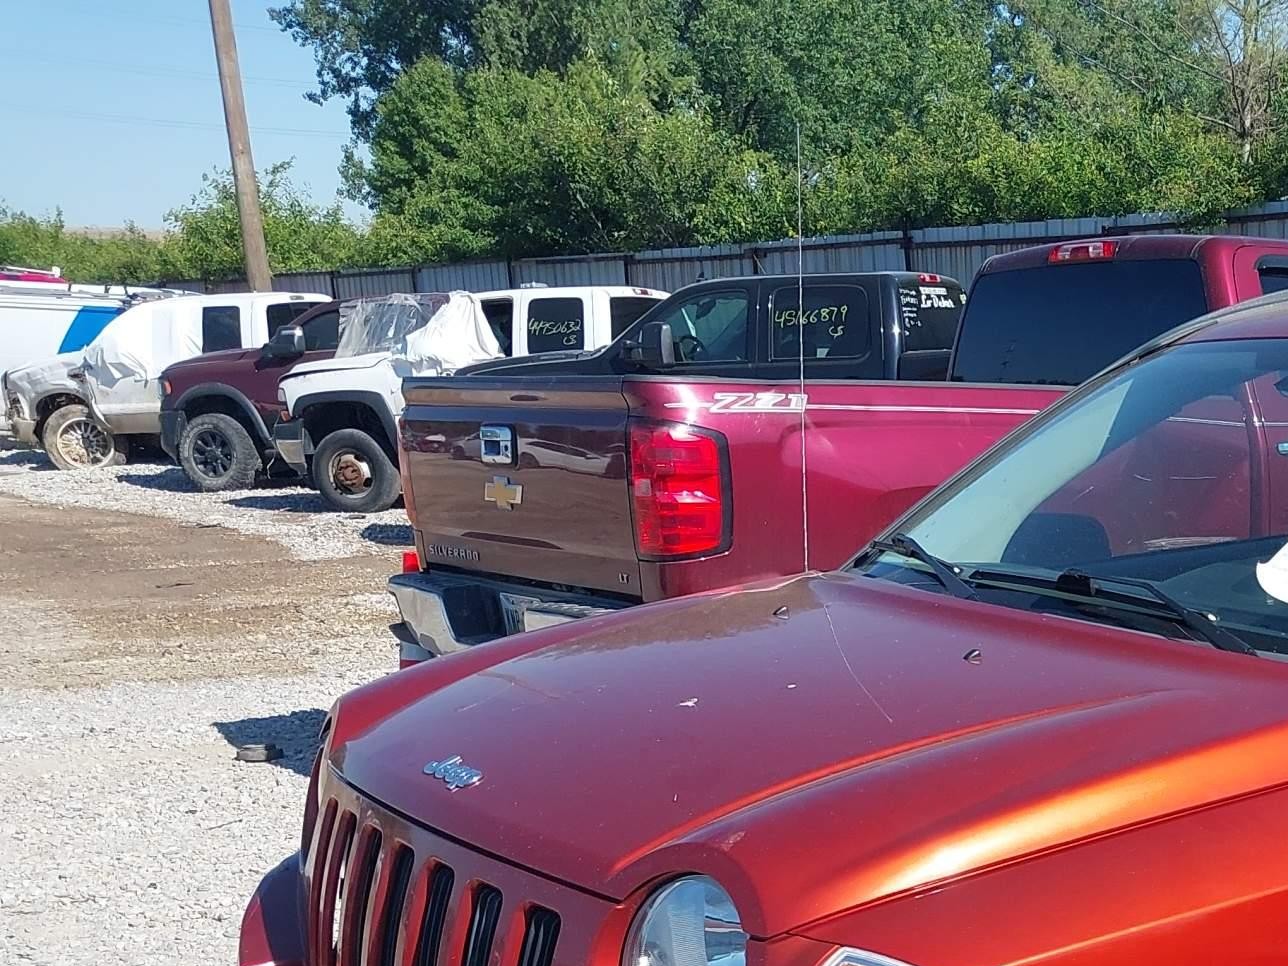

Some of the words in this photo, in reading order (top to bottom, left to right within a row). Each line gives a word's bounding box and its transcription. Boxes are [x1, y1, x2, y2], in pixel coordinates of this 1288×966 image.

[709, 392, 808, 413] Z71
[429, 545, 480, 561] SILVERADO
[619, 572, 632, 584] LT
[423, 755, 484, 792] Jeep
